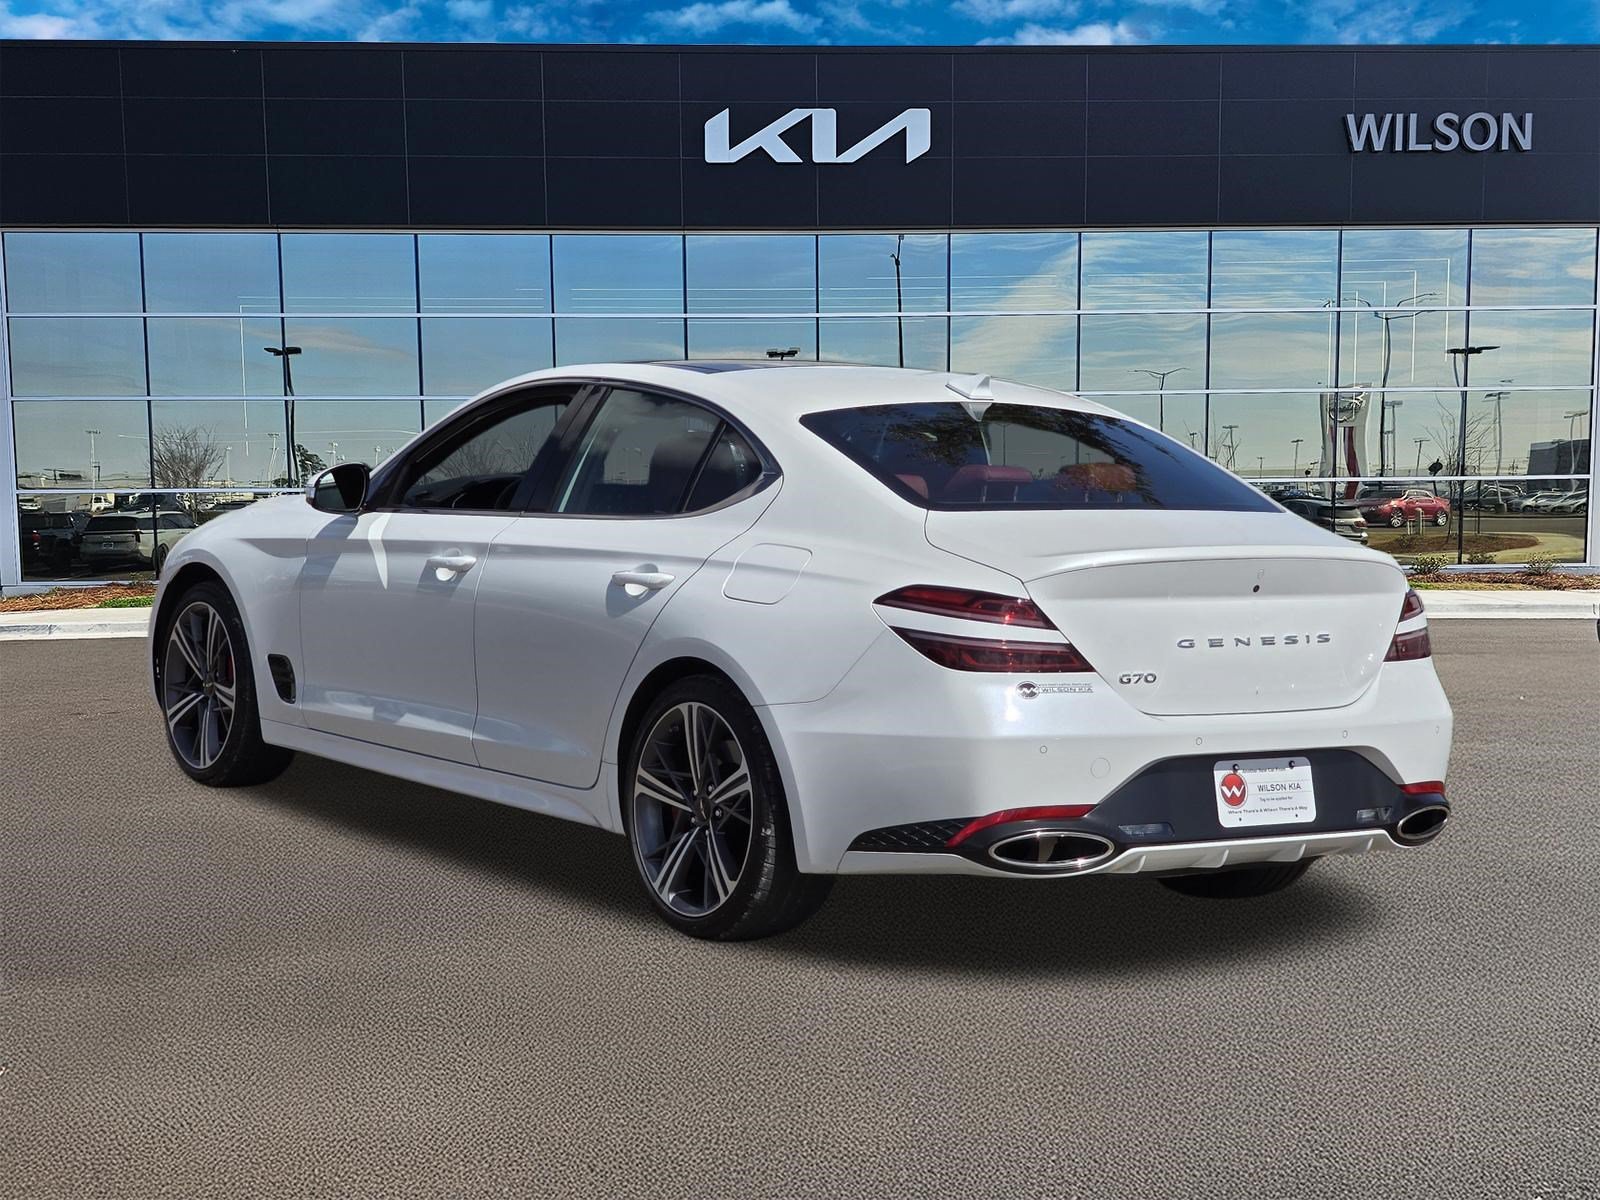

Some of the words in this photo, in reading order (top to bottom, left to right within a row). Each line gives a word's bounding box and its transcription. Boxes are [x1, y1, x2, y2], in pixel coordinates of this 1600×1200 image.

[704, 107, 931, 164] KIA
[1345, 112, 1534, 152] WILSON
[1177, 633, 1331, 649] GENESIS
[1119, 673, 1157, 684] G70
[1257, 784, 1287, 792] WILSON
[1289, 783, 1302, 791] KIA
